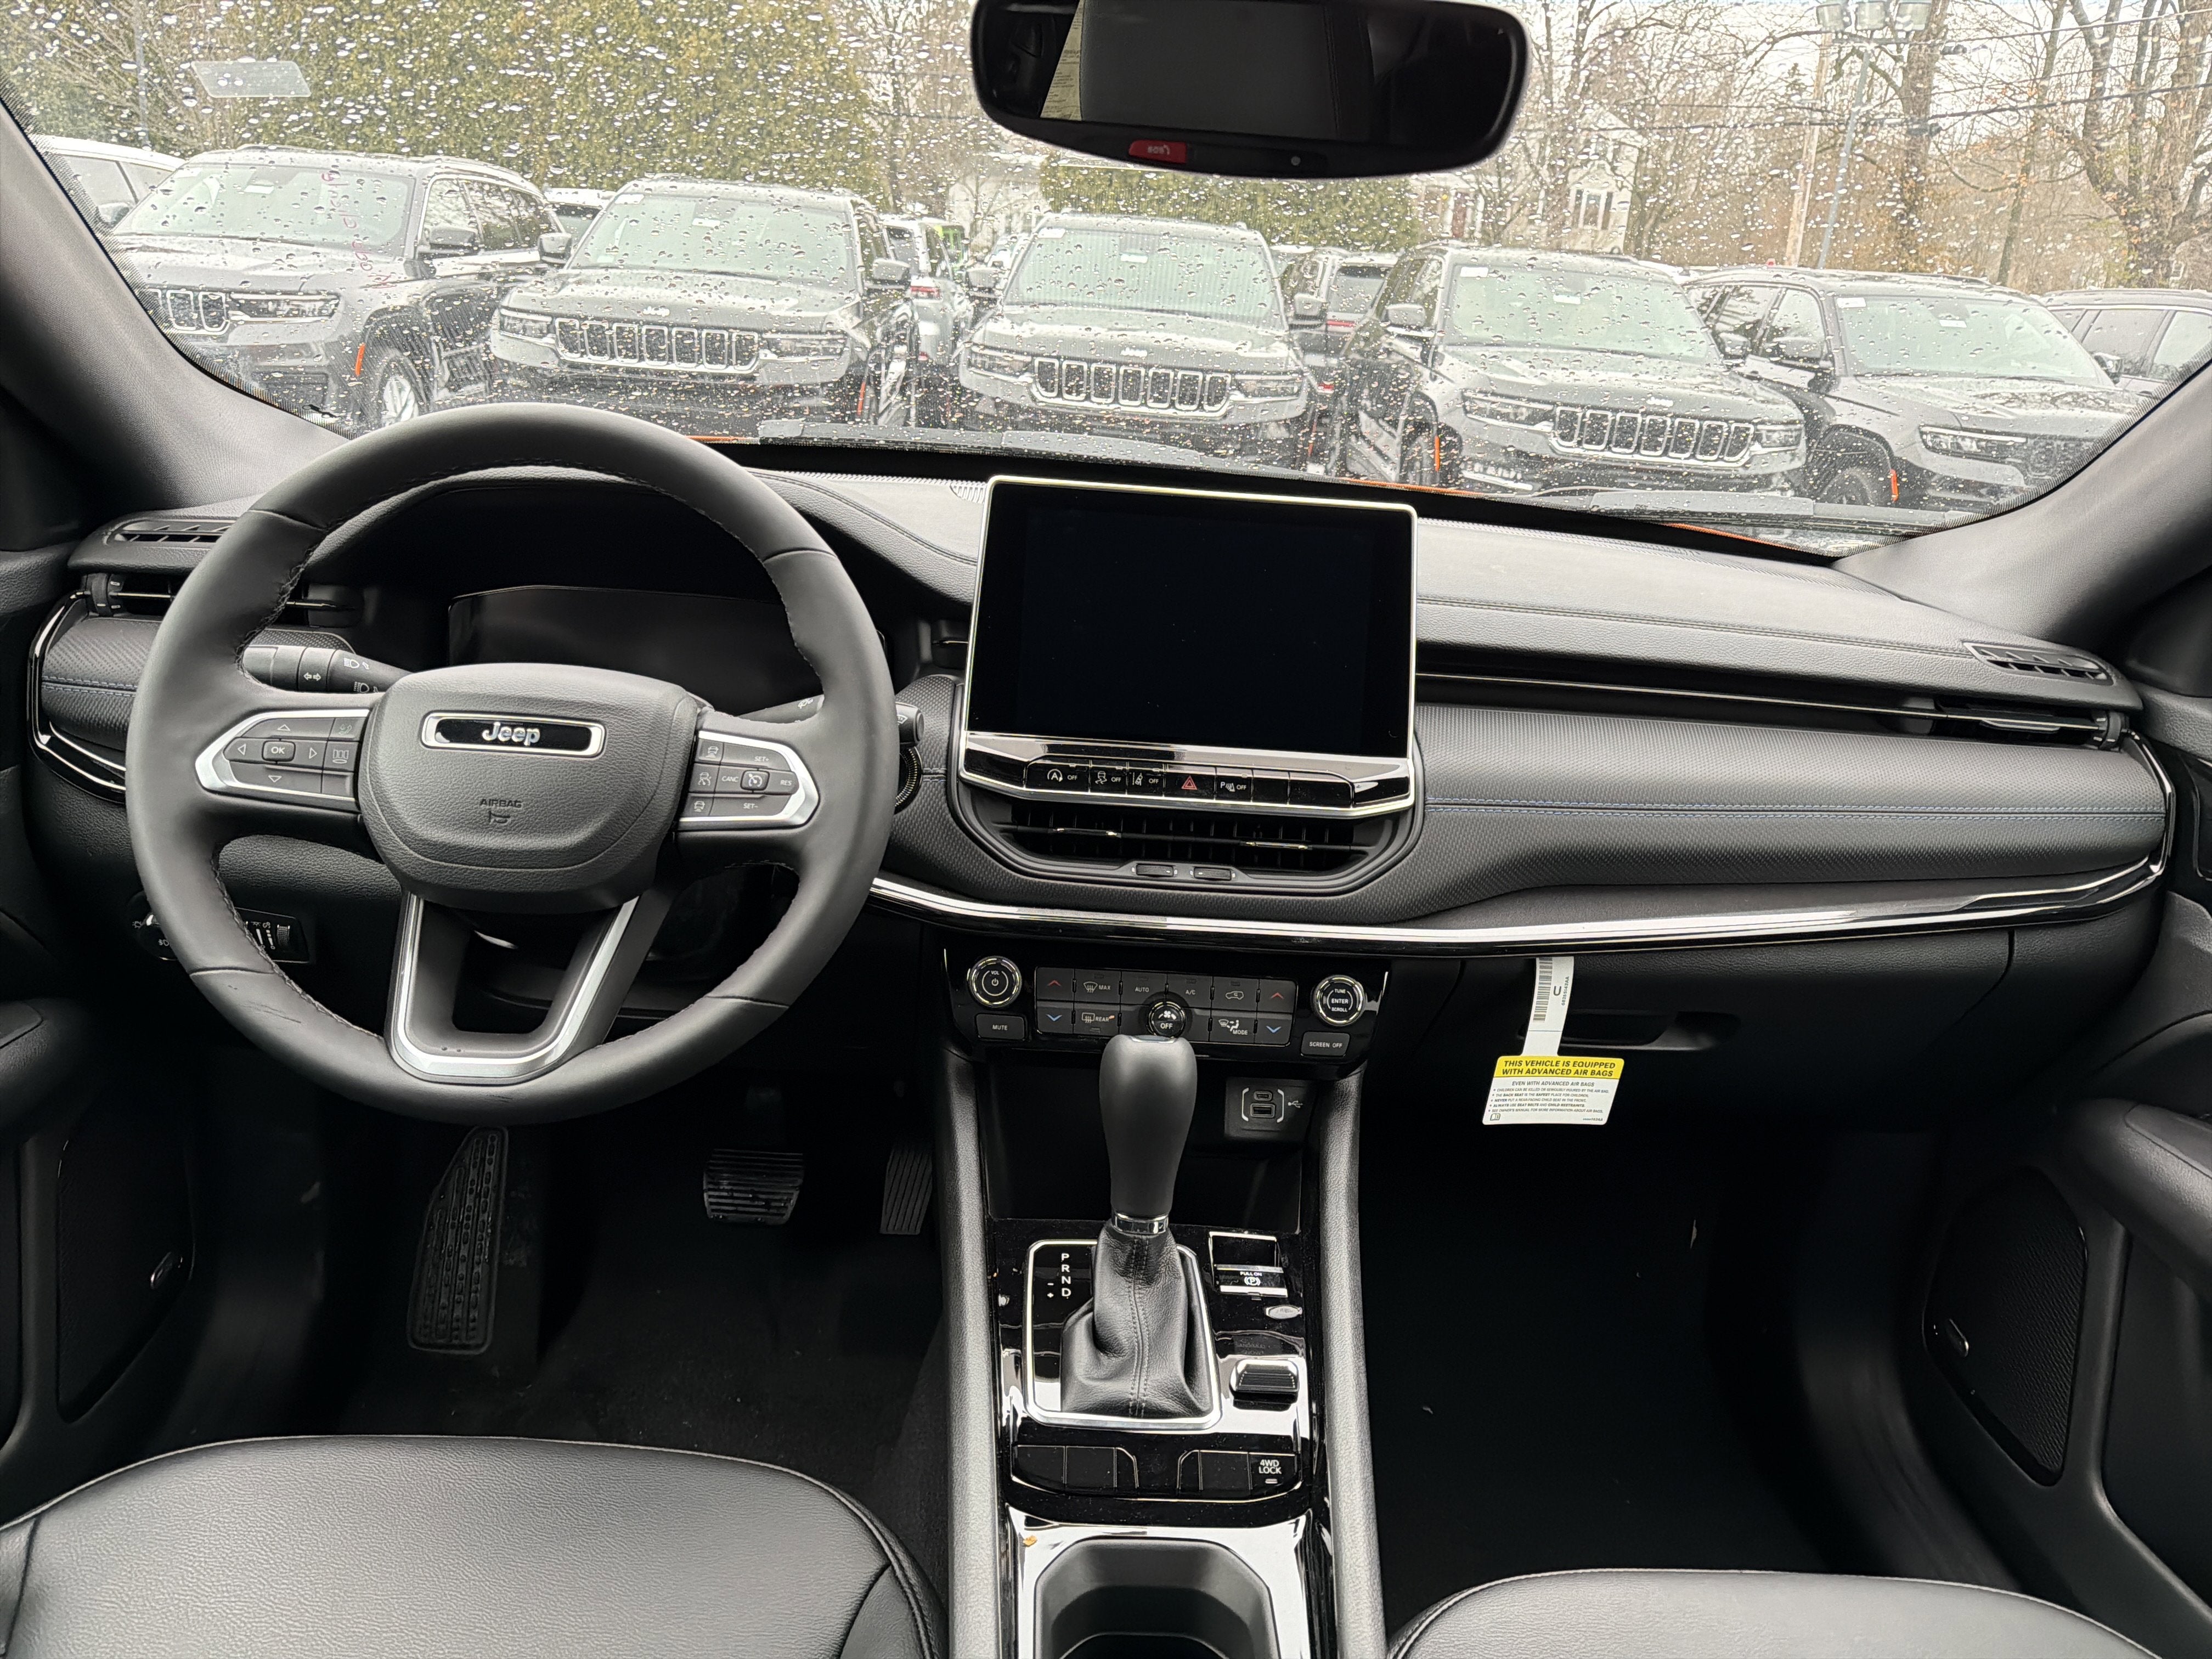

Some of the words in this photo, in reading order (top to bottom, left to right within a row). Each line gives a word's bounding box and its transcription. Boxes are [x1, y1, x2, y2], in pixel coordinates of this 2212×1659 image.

[482, 721, 540, 746] Jeep
[479, 798, 522, 808] AIRBAG
[1553, 986, 1562, 996] U
[1061, 1264, 1070, 1272] R
[1061, 1276, 1071, 1284] N
[1061, 1288, 1071, 1297] D
